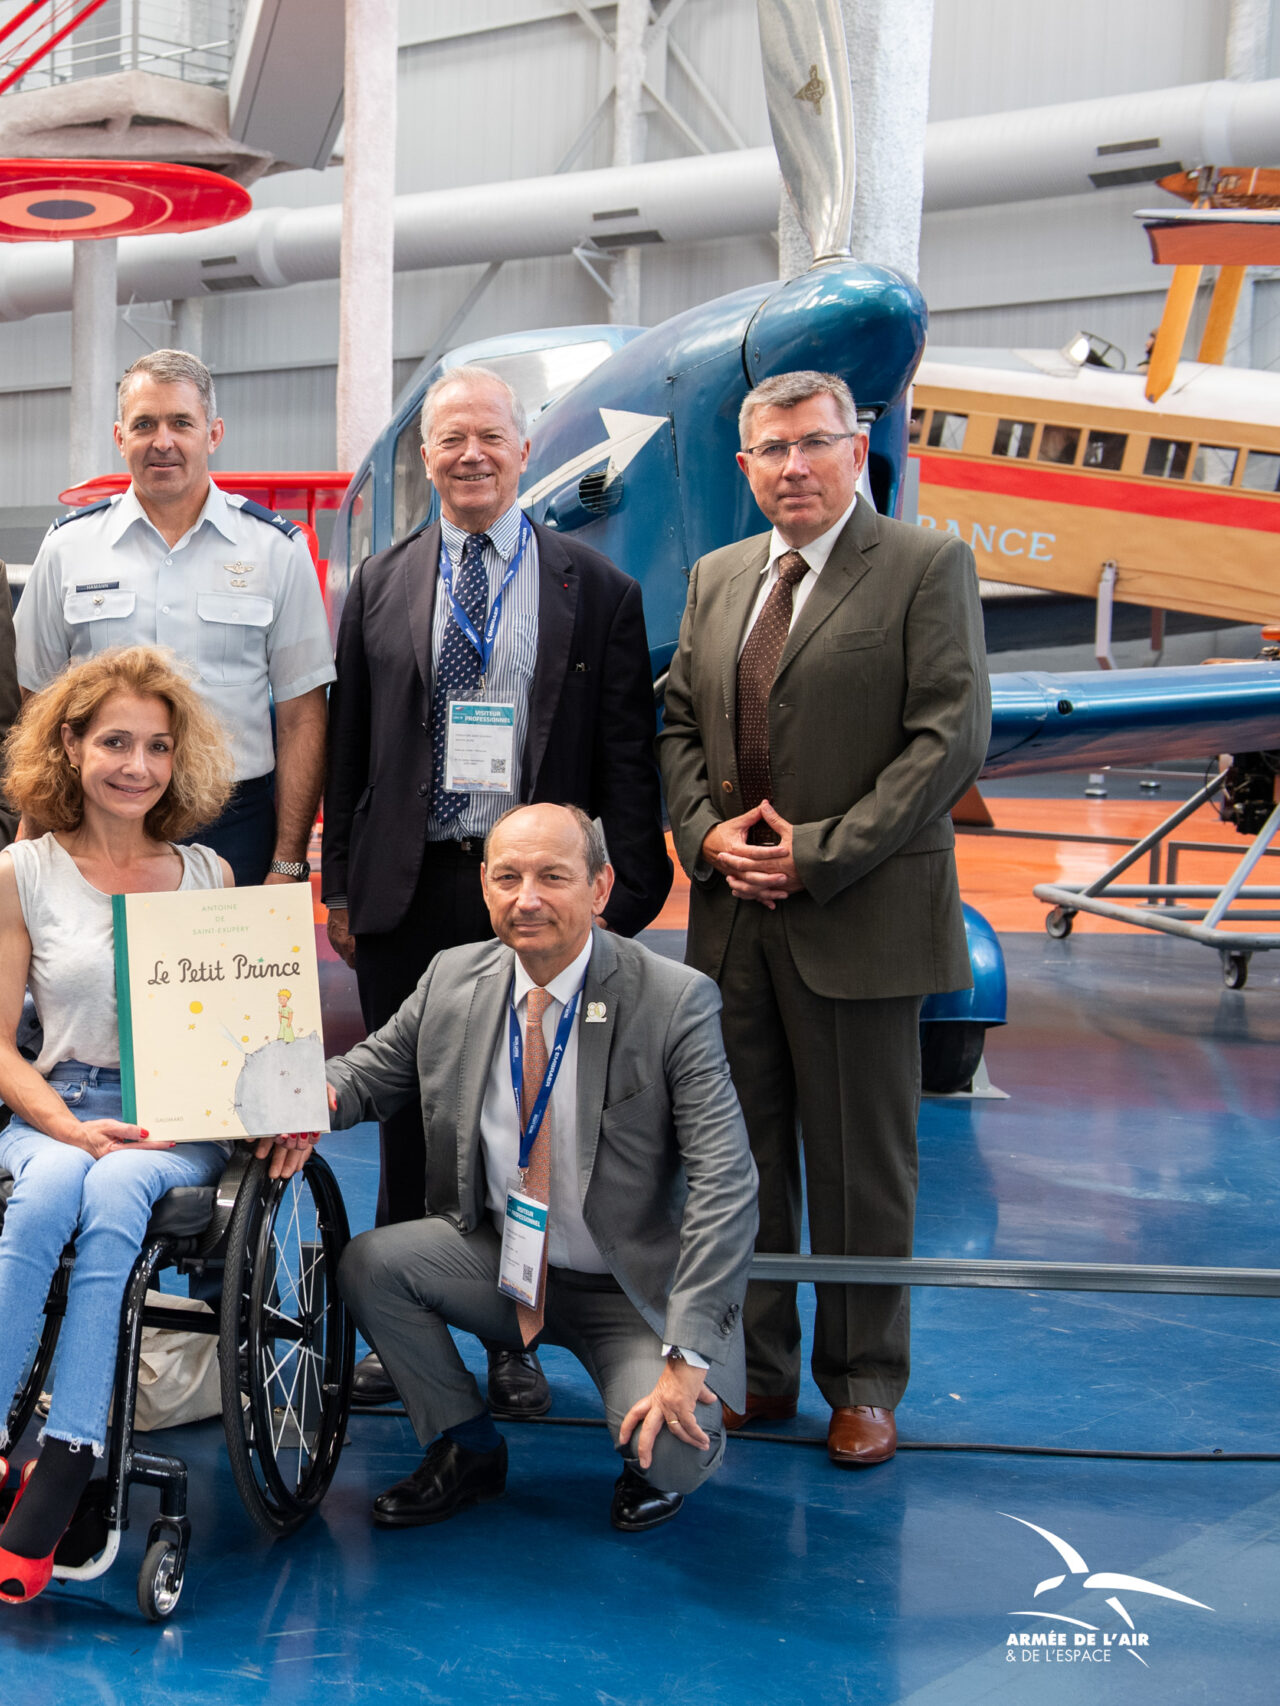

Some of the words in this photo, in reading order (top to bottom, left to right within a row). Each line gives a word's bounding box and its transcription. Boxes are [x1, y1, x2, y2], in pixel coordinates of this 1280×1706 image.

[917, 514, 1056, 562] RANCE
[488, 606, 499, 638] EMBRAER
[201, 904, 237, 912] ANTOINE
[148, 960, 170, 985] Le
[178, 958, 225, 983] Petit
[232, 954, 300, 980] Prince
[545, 1051, 560, 1088] EMBRAER
